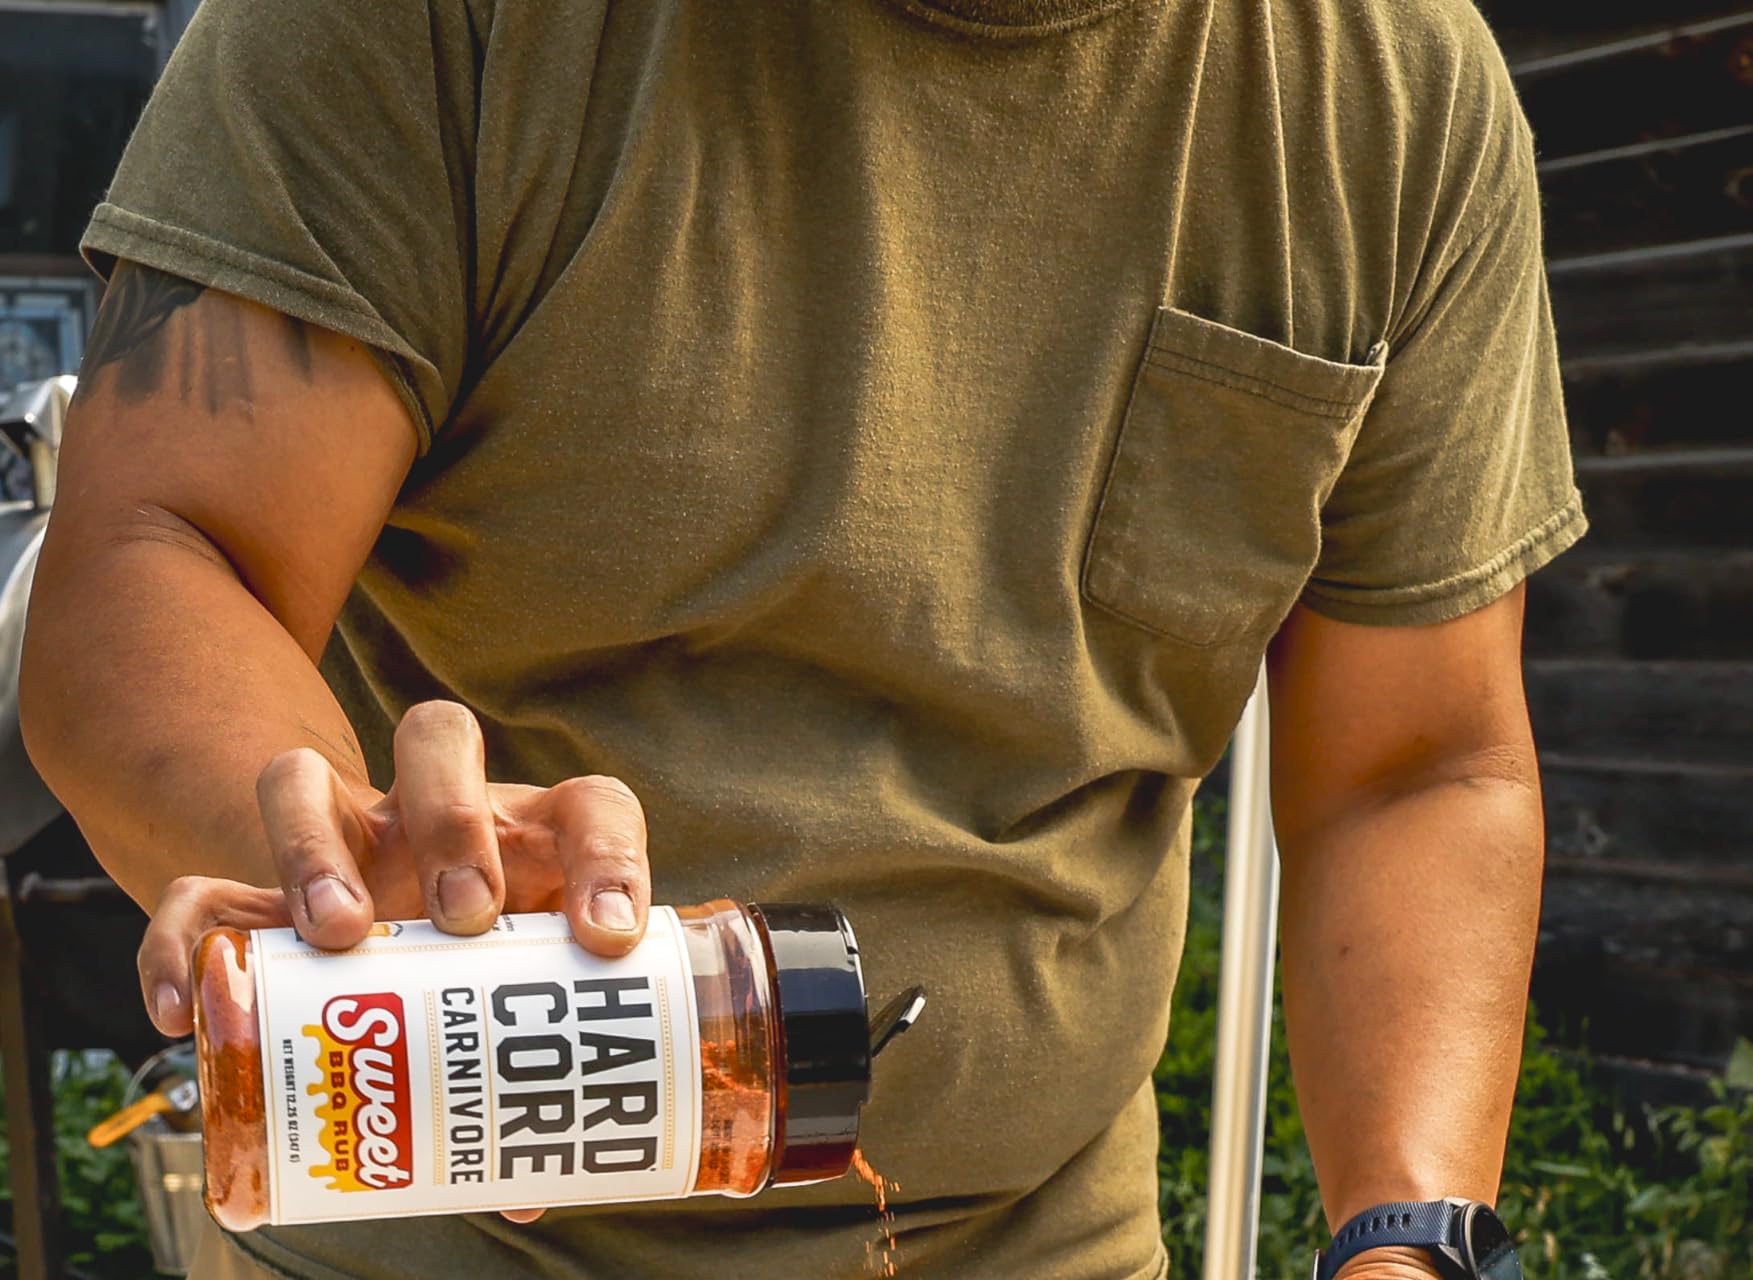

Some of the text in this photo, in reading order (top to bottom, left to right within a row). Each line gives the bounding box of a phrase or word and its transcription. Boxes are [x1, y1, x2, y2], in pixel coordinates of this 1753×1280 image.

[282, 1039, 293, 1054] NET
[284, 1057, 296, 1091] WEIGHT
[325, 998, 410, 1187] Sweet
[329, 1051, 349, 1171] BBQ RUB
[441, 987, 484, 1185] CARNIVORE
[491, 981, 575, 1179] CORE
[574, 976, 658, 1174] HARD
